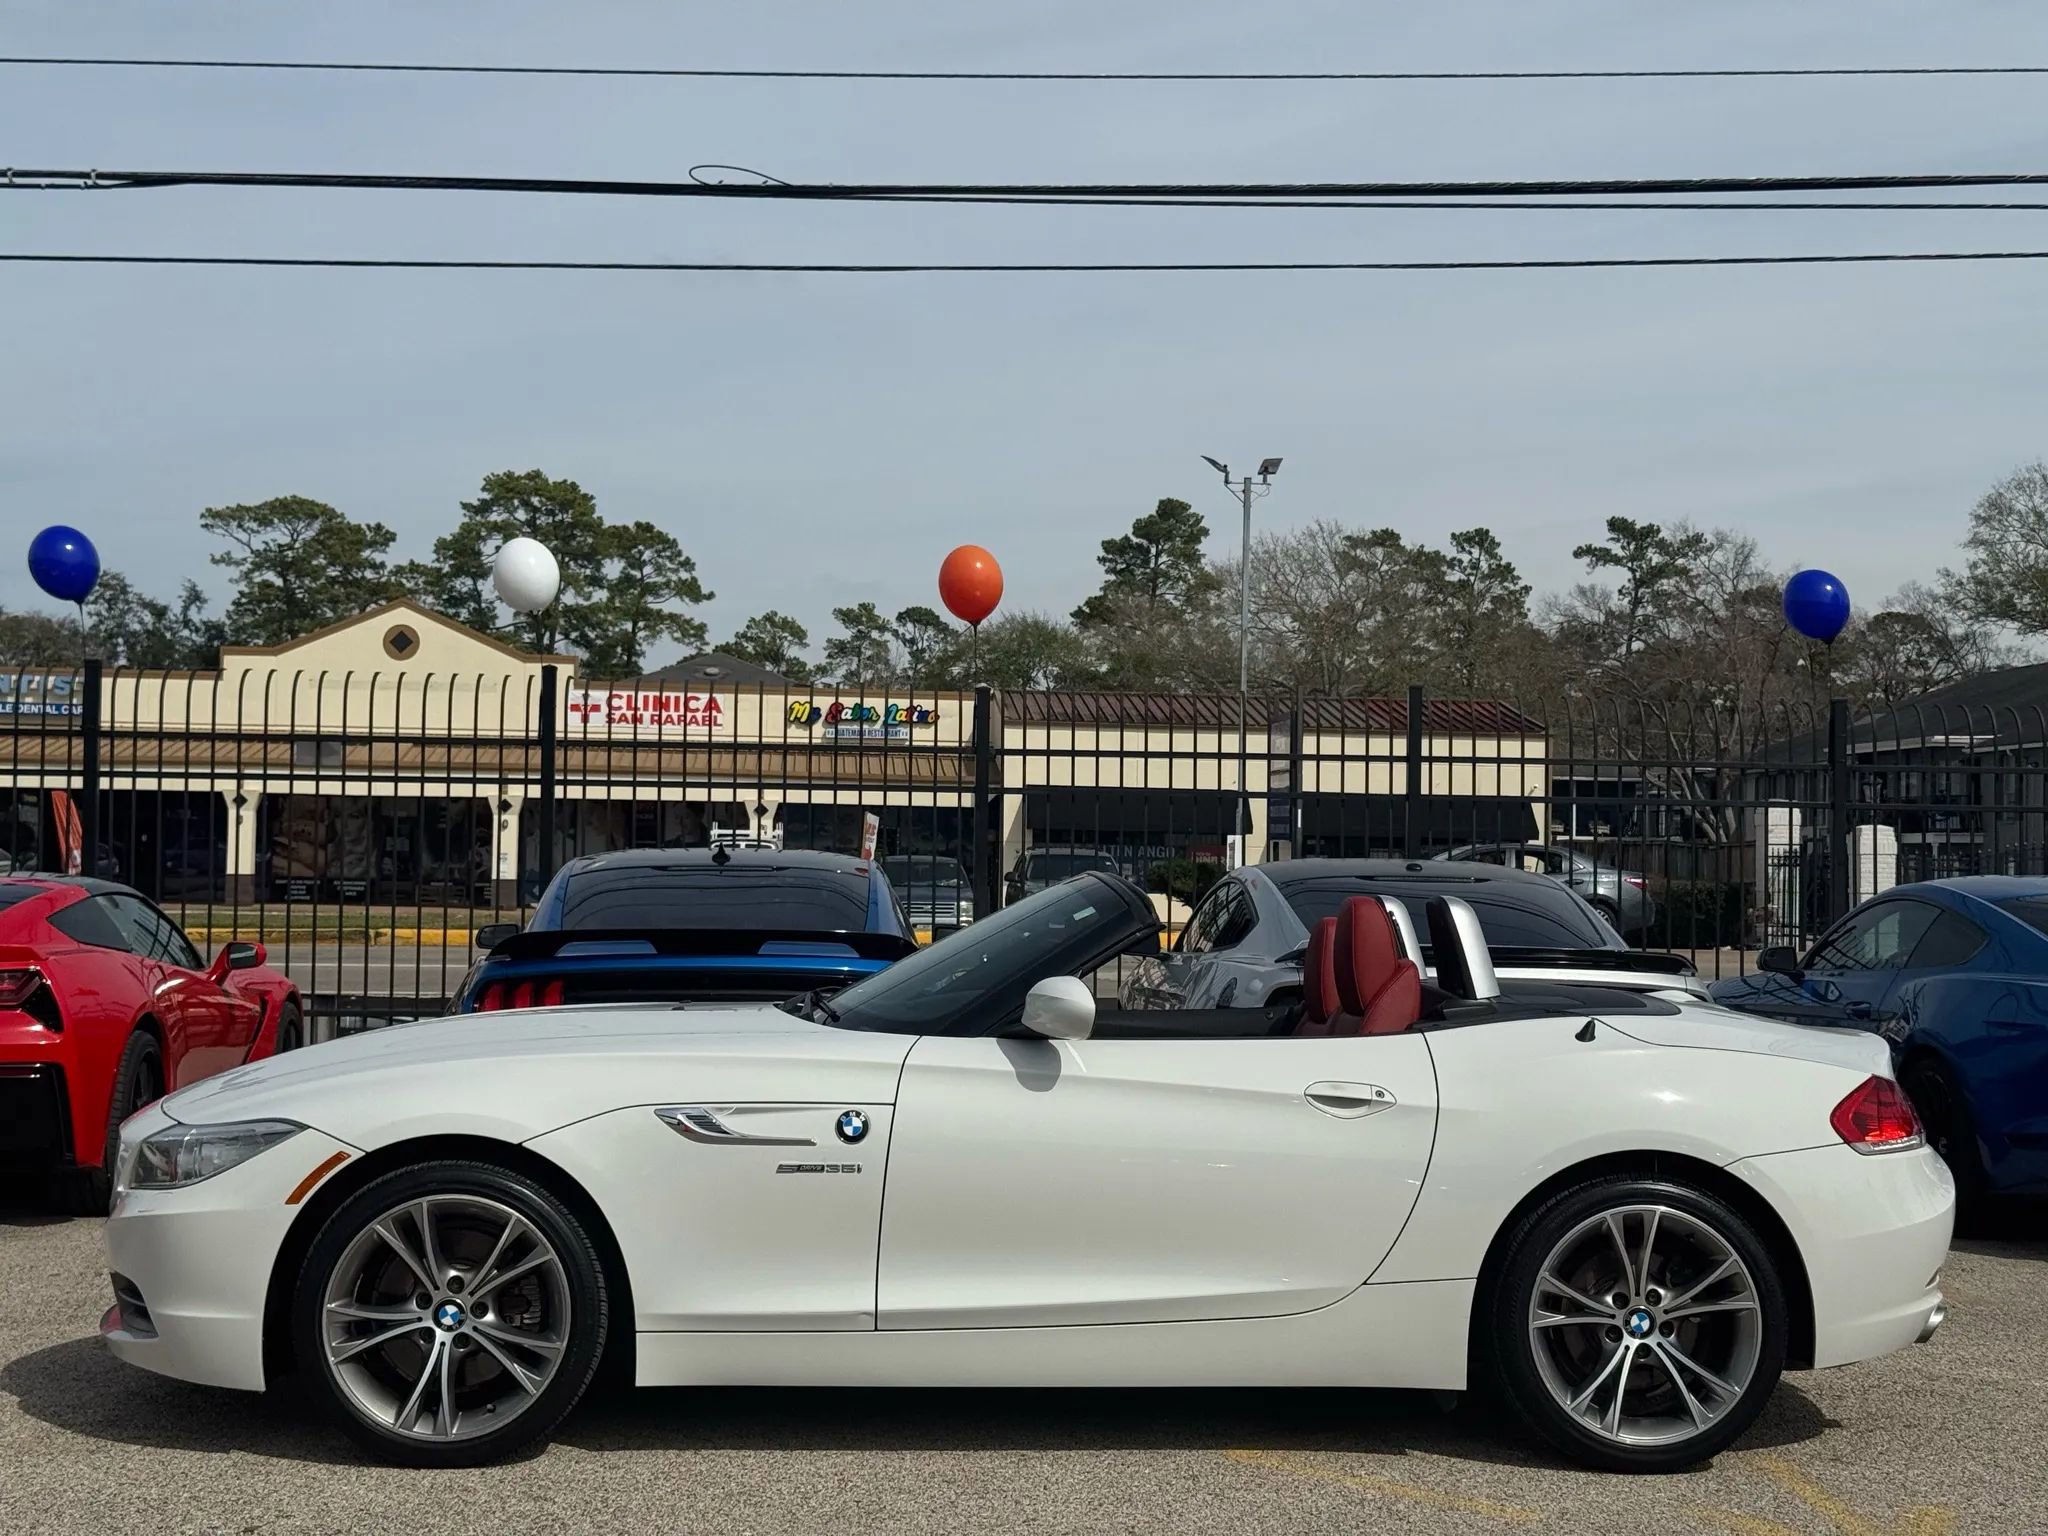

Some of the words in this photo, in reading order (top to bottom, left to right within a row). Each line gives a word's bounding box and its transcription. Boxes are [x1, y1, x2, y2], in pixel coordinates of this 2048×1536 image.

[607, 693, 723, 714] CLINICA
[61, 705, 84, 715] CAR
[605, 712, 644, 725] SAN
[650, 713, 723, 727] RAFAEL
[868, 728, 901, 737] RESTARANT
